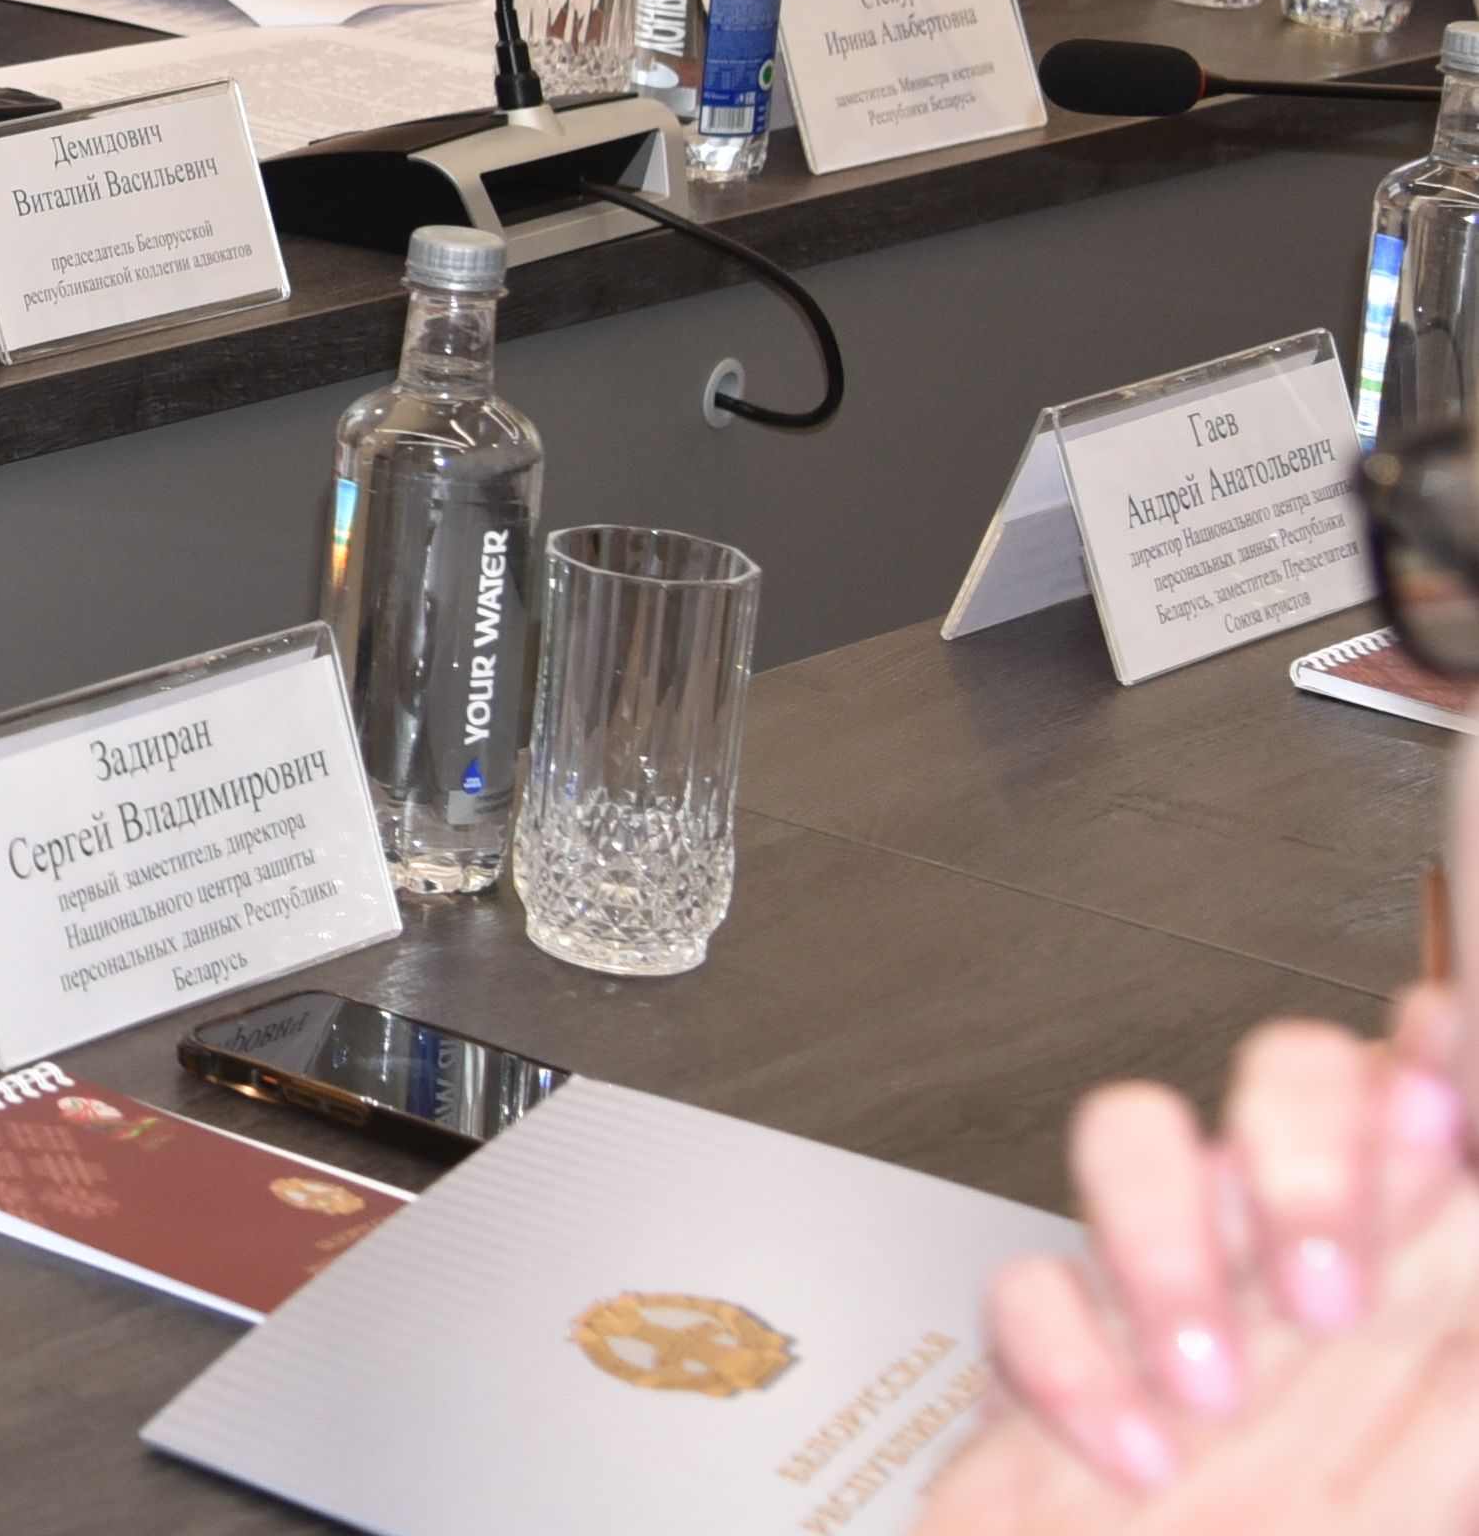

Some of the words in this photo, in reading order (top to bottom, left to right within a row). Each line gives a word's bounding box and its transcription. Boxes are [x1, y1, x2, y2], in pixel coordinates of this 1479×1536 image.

[825, 26, 877, 59] Ирина
[881, 8, 977, 41] Альбертовна
[51, 123, 163, 169] Демидович
[12, 174, 102, 217] Виталий
[104, 156, 219, 197] Васильевич
[23, 267, 133, 312] республиканской
[135, 256, 191, 283] коллегии
[193, 241, 253, 271] адвокатов
[51, 239, 135, 273] председатель
[135, 219, 213, 254] Белорусской
[1188, 409, 1239, 448] Гаев
[1127, 473, 1205, 529] Андрей
[1210, 437, 1336, 503] Анатольевич
[1130, 533, 1183, 569] директор
[1183, 507, 1271, 548] Национального
[1271, 493, 1312, 516] центра
[1154, 549, 1235, 594] персональных
[1237, 534, 1280, 568] данных
[1278, 513, 1346, 547] Республики
[474, 528, 509, 651] WATER
[1156, 590, 1214, 625] Беларусь,
[1215, 567, 1283, 607] заместитель
[1281, 540, 1360, 581] Председателя
[1225, 603, 1264, 635] Союза
[1265, 590, 1312, 628] юристов
[464, 653, 496, 746] YOUR
[89, 718, 214, 782] Задиран
[9, 814, 114, 881] Сергей
[116, 749, 330, 844] Владимирович
[58, 876, 121, 913] первый
[123, 842, 223, 894] заместитель
[226, 812, 307, 864] директора
[64, 889, 194, 951] Национального
[197, 872, 253, 912] центра
[254, 845, 316, 884] защиты
[60, 935, 177, 994] персональных
[181, 916, 242, 956] данных
[244, 877, 339, 931] Республики
[173, 950, 249, 994] Беларусь
